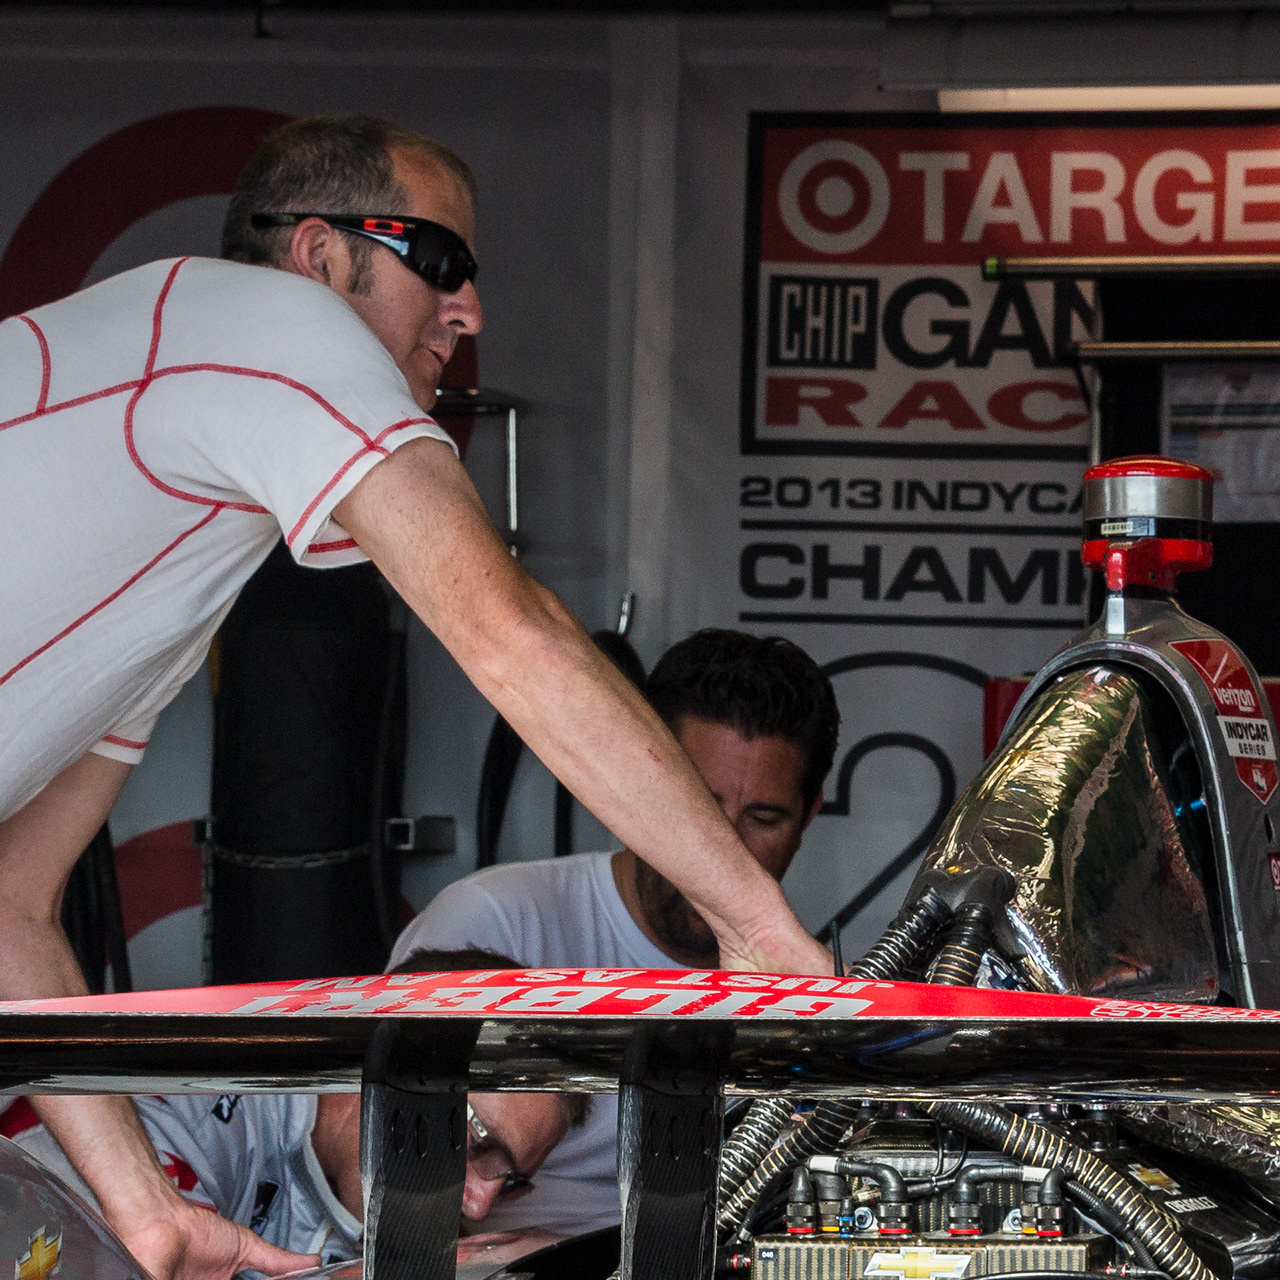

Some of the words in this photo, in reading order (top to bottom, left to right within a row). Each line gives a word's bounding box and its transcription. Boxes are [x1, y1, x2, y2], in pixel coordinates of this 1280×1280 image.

[780, 284, 869, 363] CHIP
[739, 475, 883, 509] 2013
[1213, 682, 1256, 713] verizon
[1224, 721, 1270, 743] INDYCAR
[1238, 742, 1268, 757] SERIES
[654, 971, 895, 995] JUST
